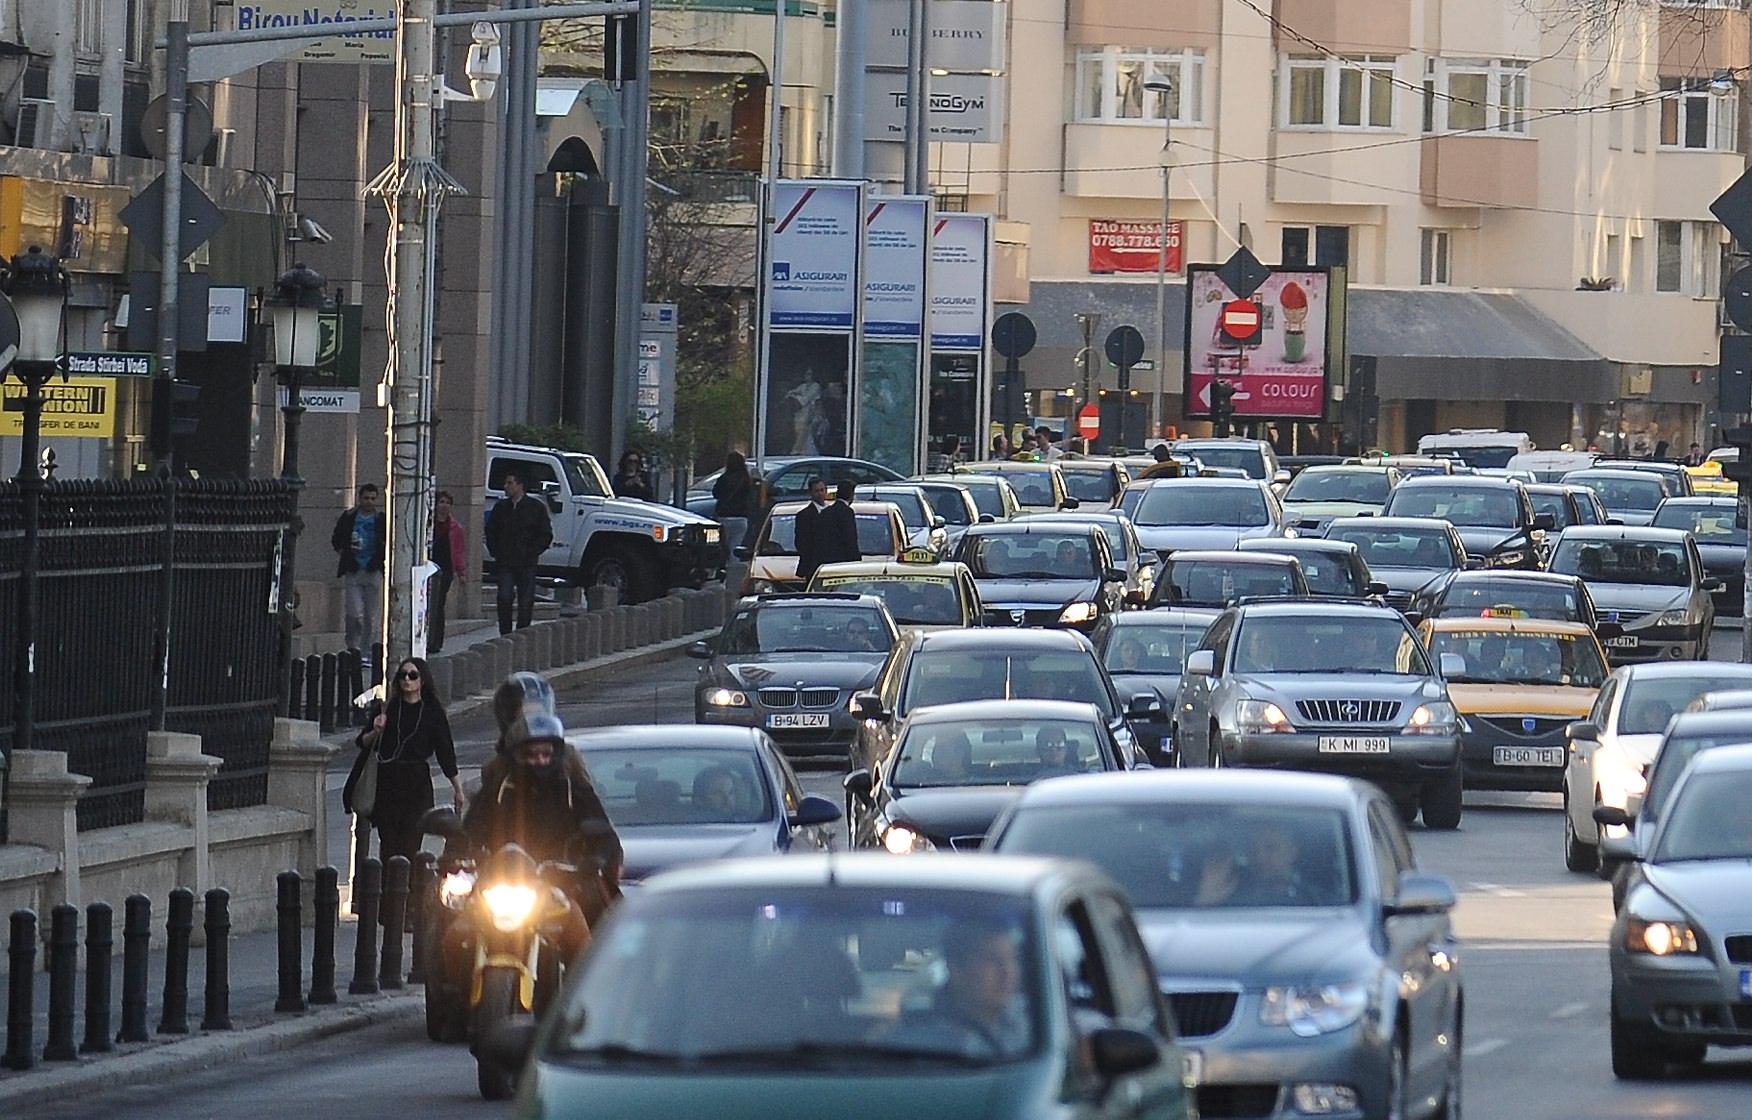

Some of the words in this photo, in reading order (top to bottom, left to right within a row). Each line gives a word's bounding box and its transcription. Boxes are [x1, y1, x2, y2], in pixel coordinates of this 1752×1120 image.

[1093, 223, 1118, 233] TAO
[68, 356, 96, 372] Strada
[43, 399, 89, 413] NION
[300, 396, 344, 407] ANCOMAT
[64, 420, 76, 429] DE
[79, 420, 100, 429] BANI
[911, 551, 928, 560] TAXI
[774, 715, 782, 726] B
[786, 715, 799, 726] 94
[803, 715, 825, 726] LZV
[1328, 738, 1337, 750] K
[1343, 738, 1358, 751] MI
[1364, 738, 1386, 751] 999
[1504, 749, 1512, 761] B
[1516, 750, 1530, 762] 60
